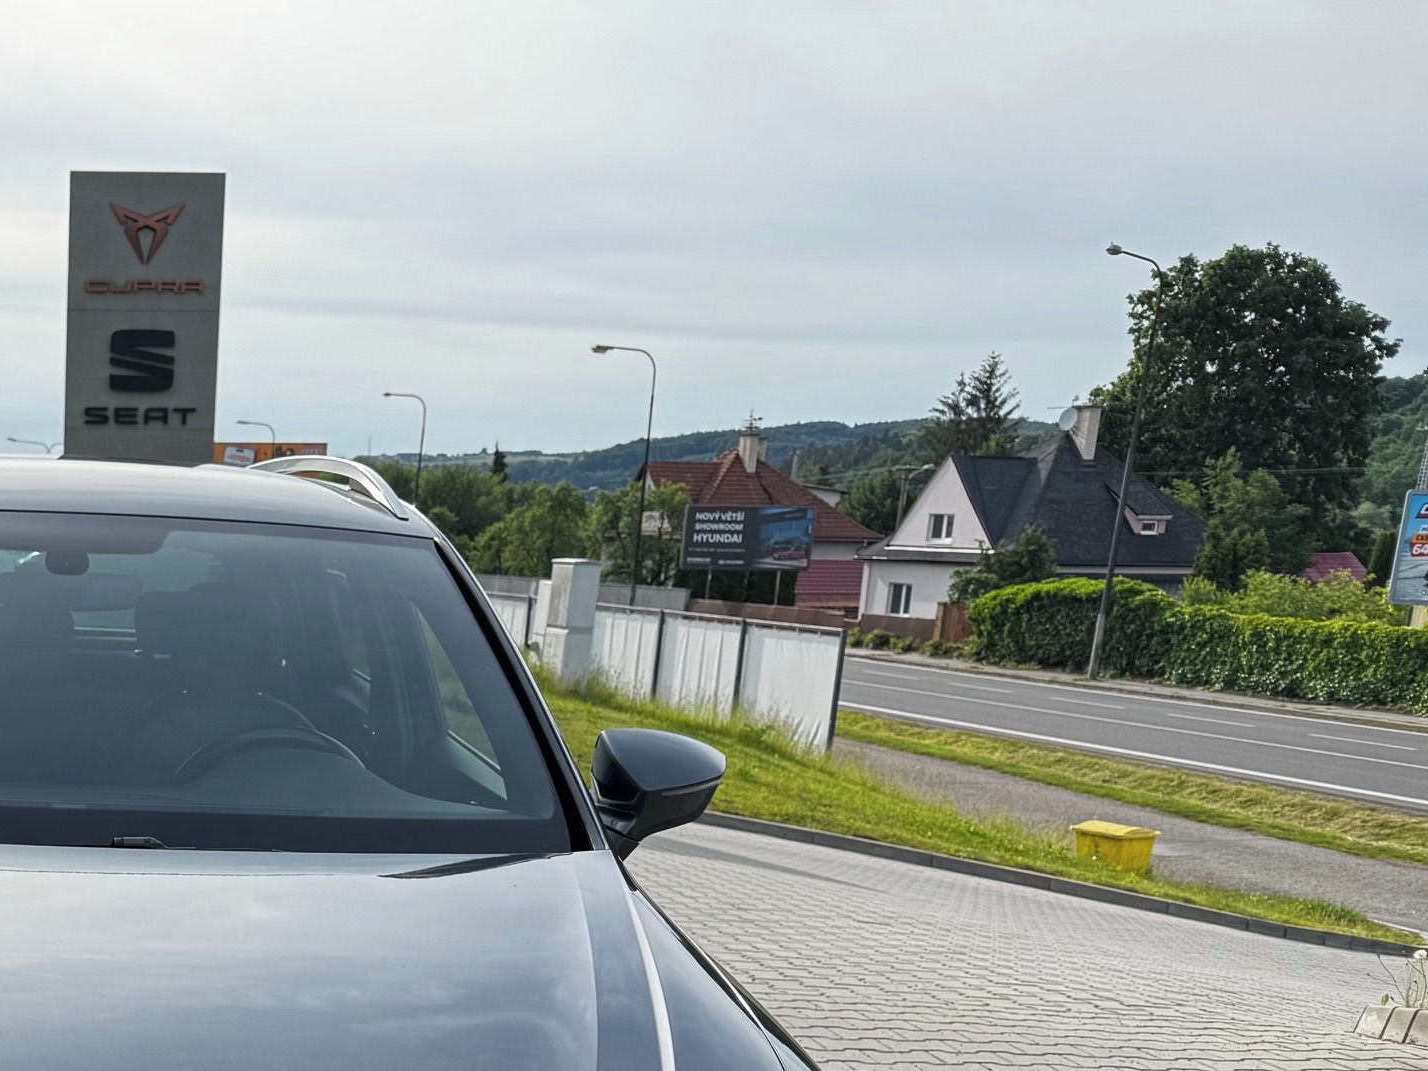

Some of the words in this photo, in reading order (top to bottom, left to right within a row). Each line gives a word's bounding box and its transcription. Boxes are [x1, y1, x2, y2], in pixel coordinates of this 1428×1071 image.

[83, 278, 205, 295] CUPRA
[83, 406, 197, 426] SEAT
[695, 511, 721, 521] NOVÝ
[721, 511, 745, 521] VĚTŠÍ
[694, 522, 744, 531] SHOWROOM
[693, 533, 743, 543] HYUNDAI
